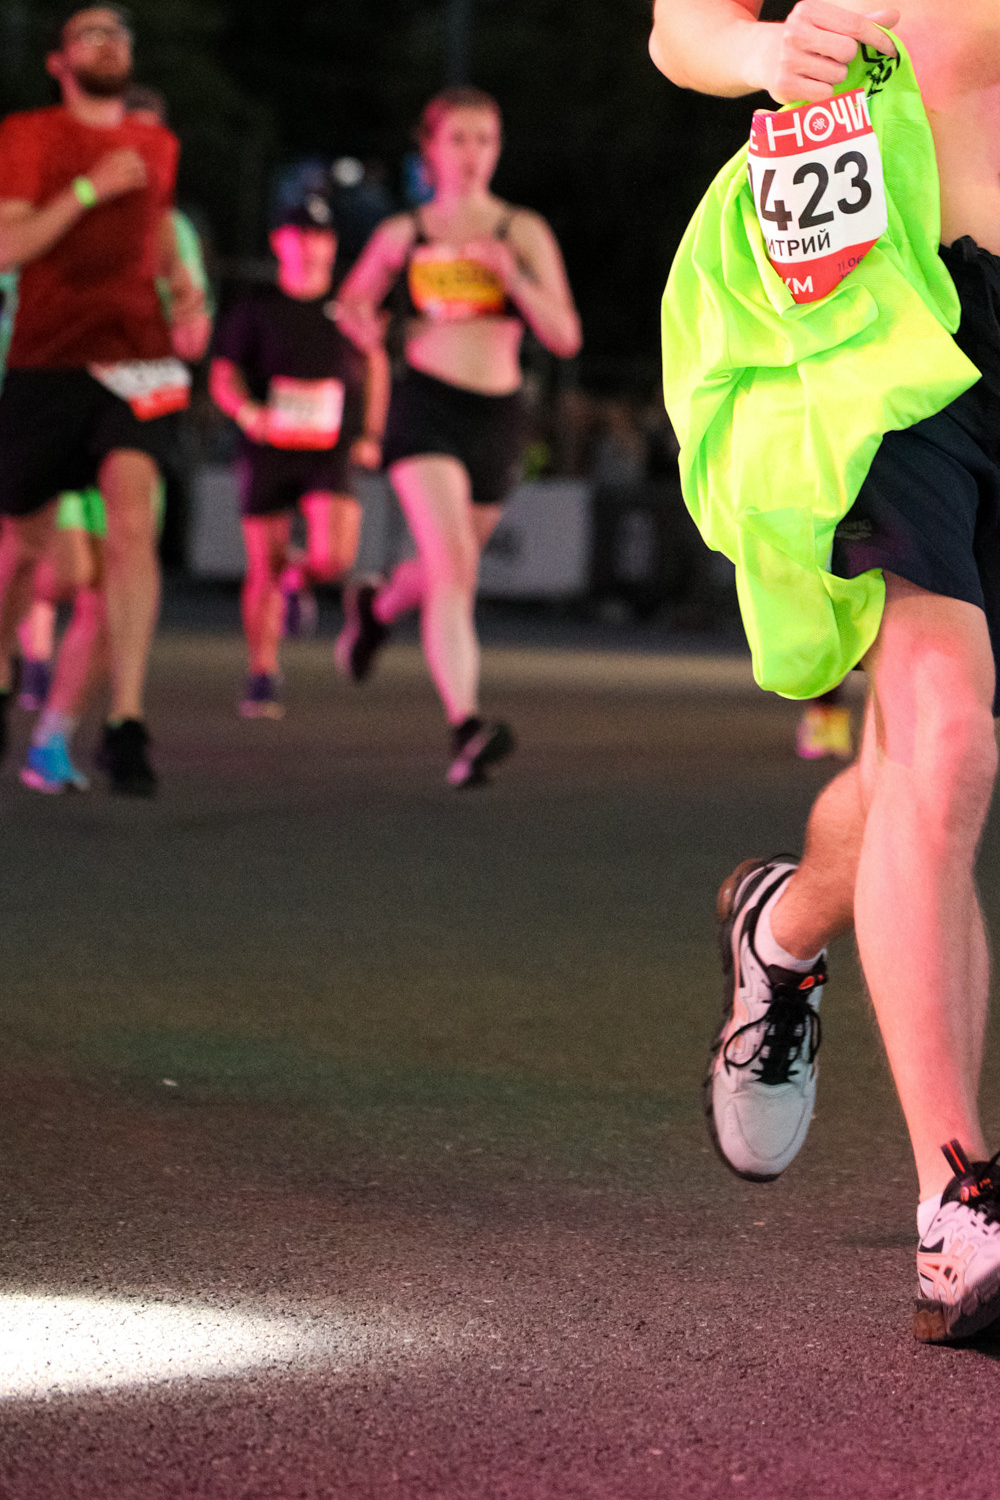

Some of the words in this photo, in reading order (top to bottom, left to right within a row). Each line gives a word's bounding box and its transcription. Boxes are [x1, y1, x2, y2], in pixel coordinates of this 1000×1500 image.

[765, 90, 872, 152] НОЧИ
[747, 150, 872, 231] 423
[765, 228, 831, 257] ИТРИЙ
